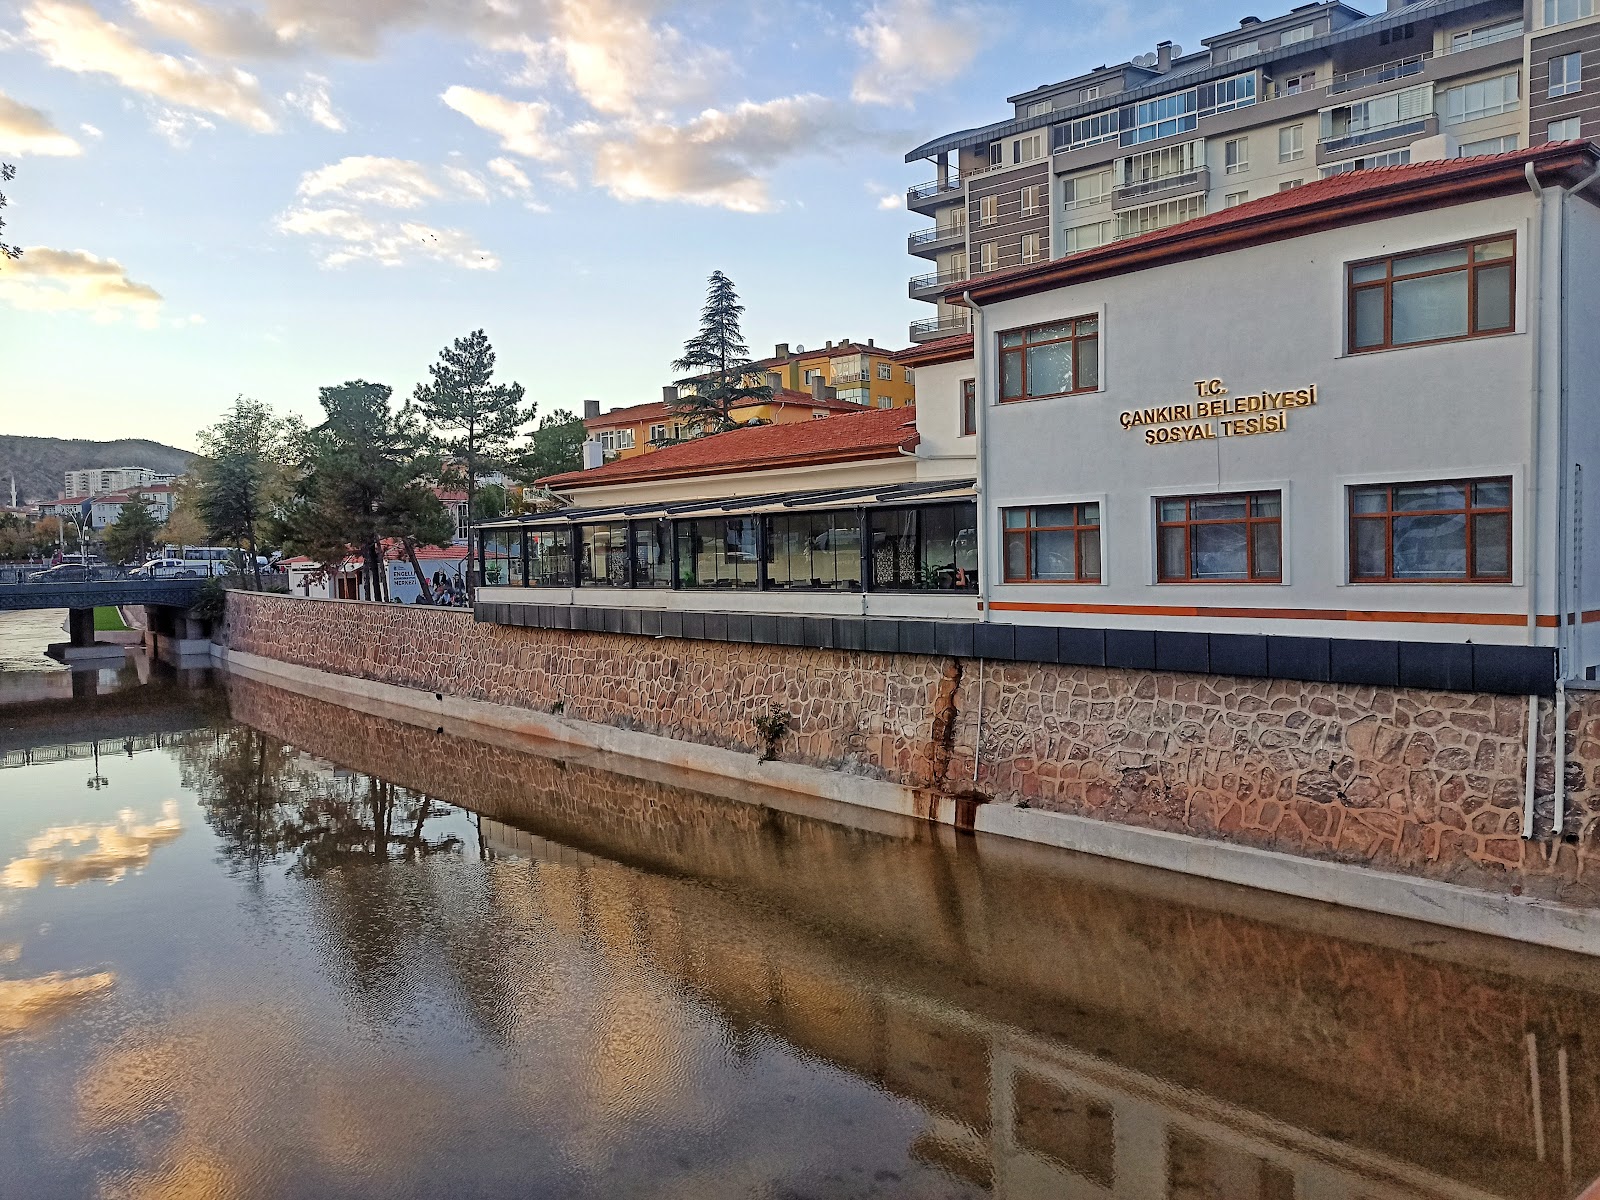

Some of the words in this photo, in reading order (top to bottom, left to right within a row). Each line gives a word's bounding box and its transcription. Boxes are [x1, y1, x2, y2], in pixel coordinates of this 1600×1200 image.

[1194, 378, 1228, 397] T.C.
[1119, 403, 1192, 431] ÇANKIRI
[1197, 383, 1318, 418] BELEDİYESİ
[1144, 422, 1216, 445] SOSYAL
[1220, 409, 1288, 437] TESİSİ
